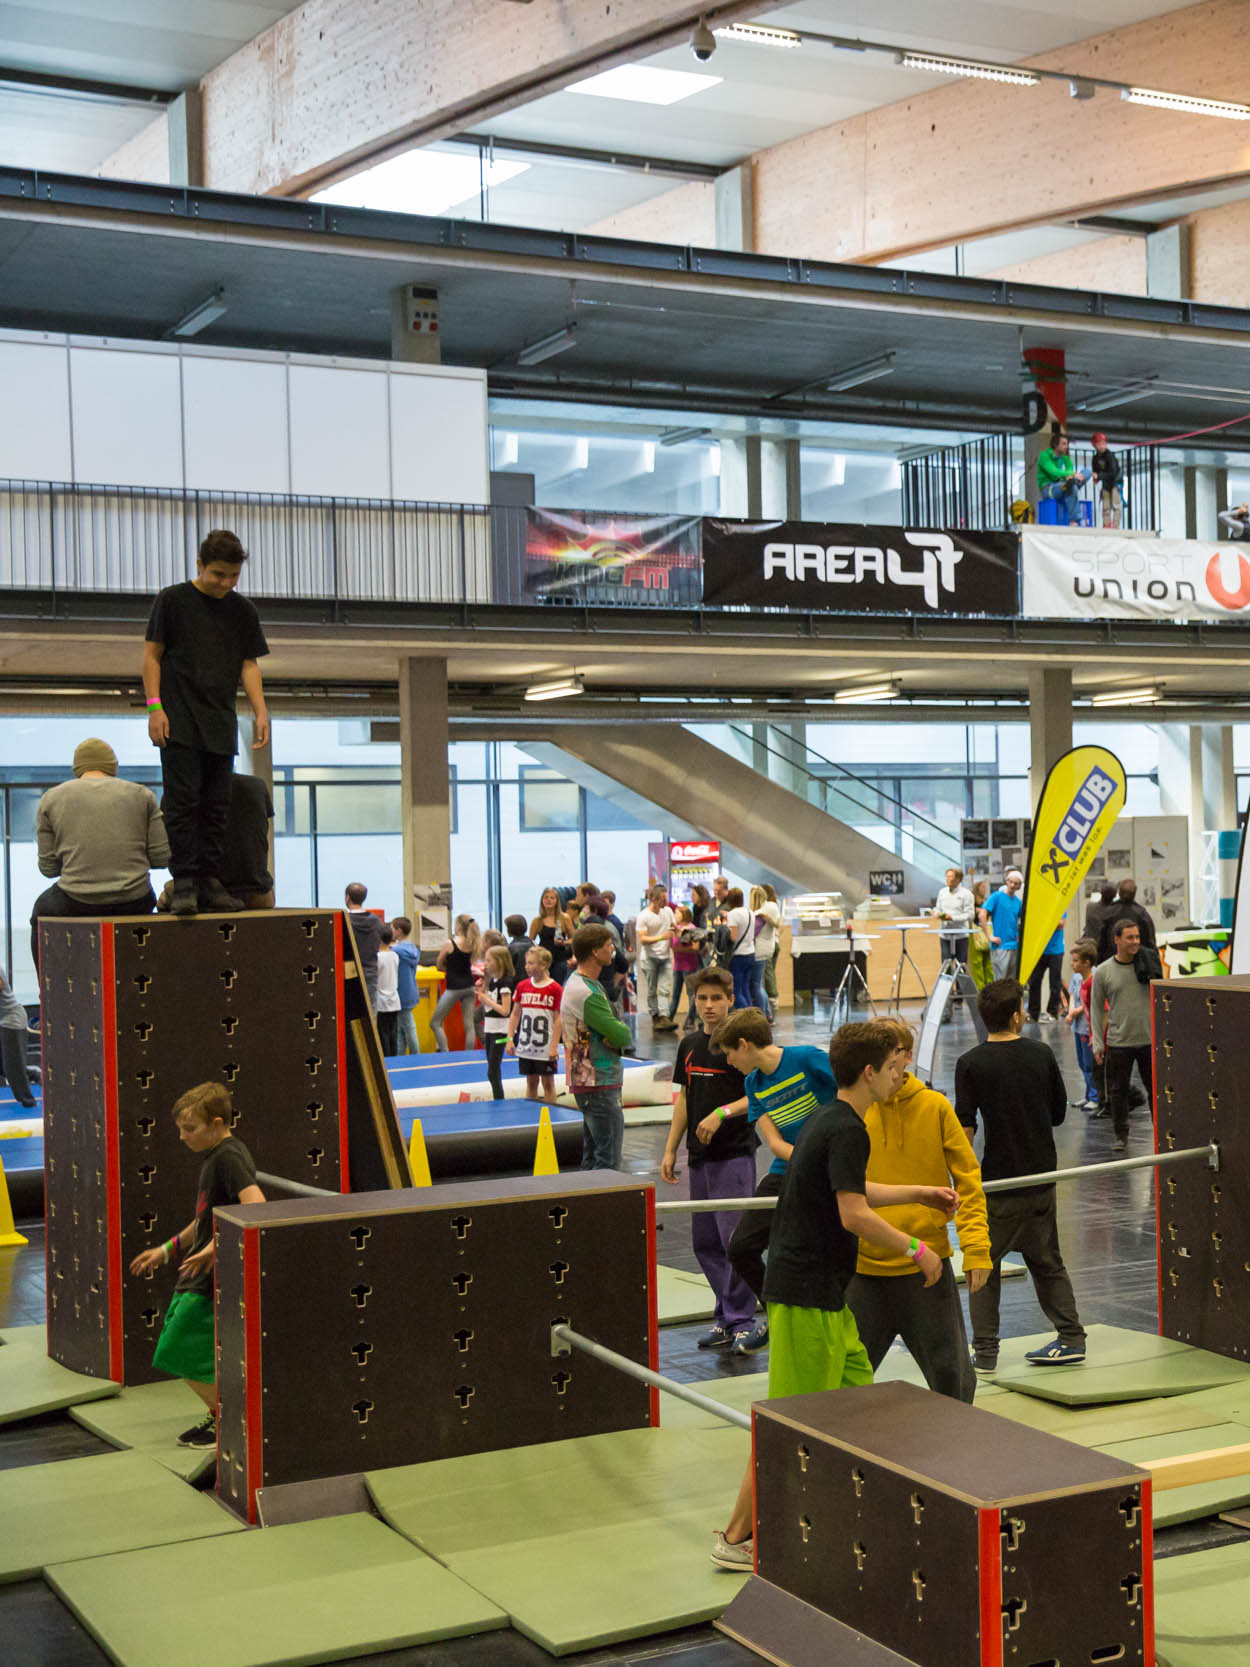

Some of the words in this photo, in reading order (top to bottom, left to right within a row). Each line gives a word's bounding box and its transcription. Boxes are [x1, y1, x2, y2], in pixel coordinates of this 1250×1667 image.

[1071, 550, 1195, 578] SPORT
[1058, 773, 1113, 854] CLUB
[519, 1014, 550, 1048] 99
